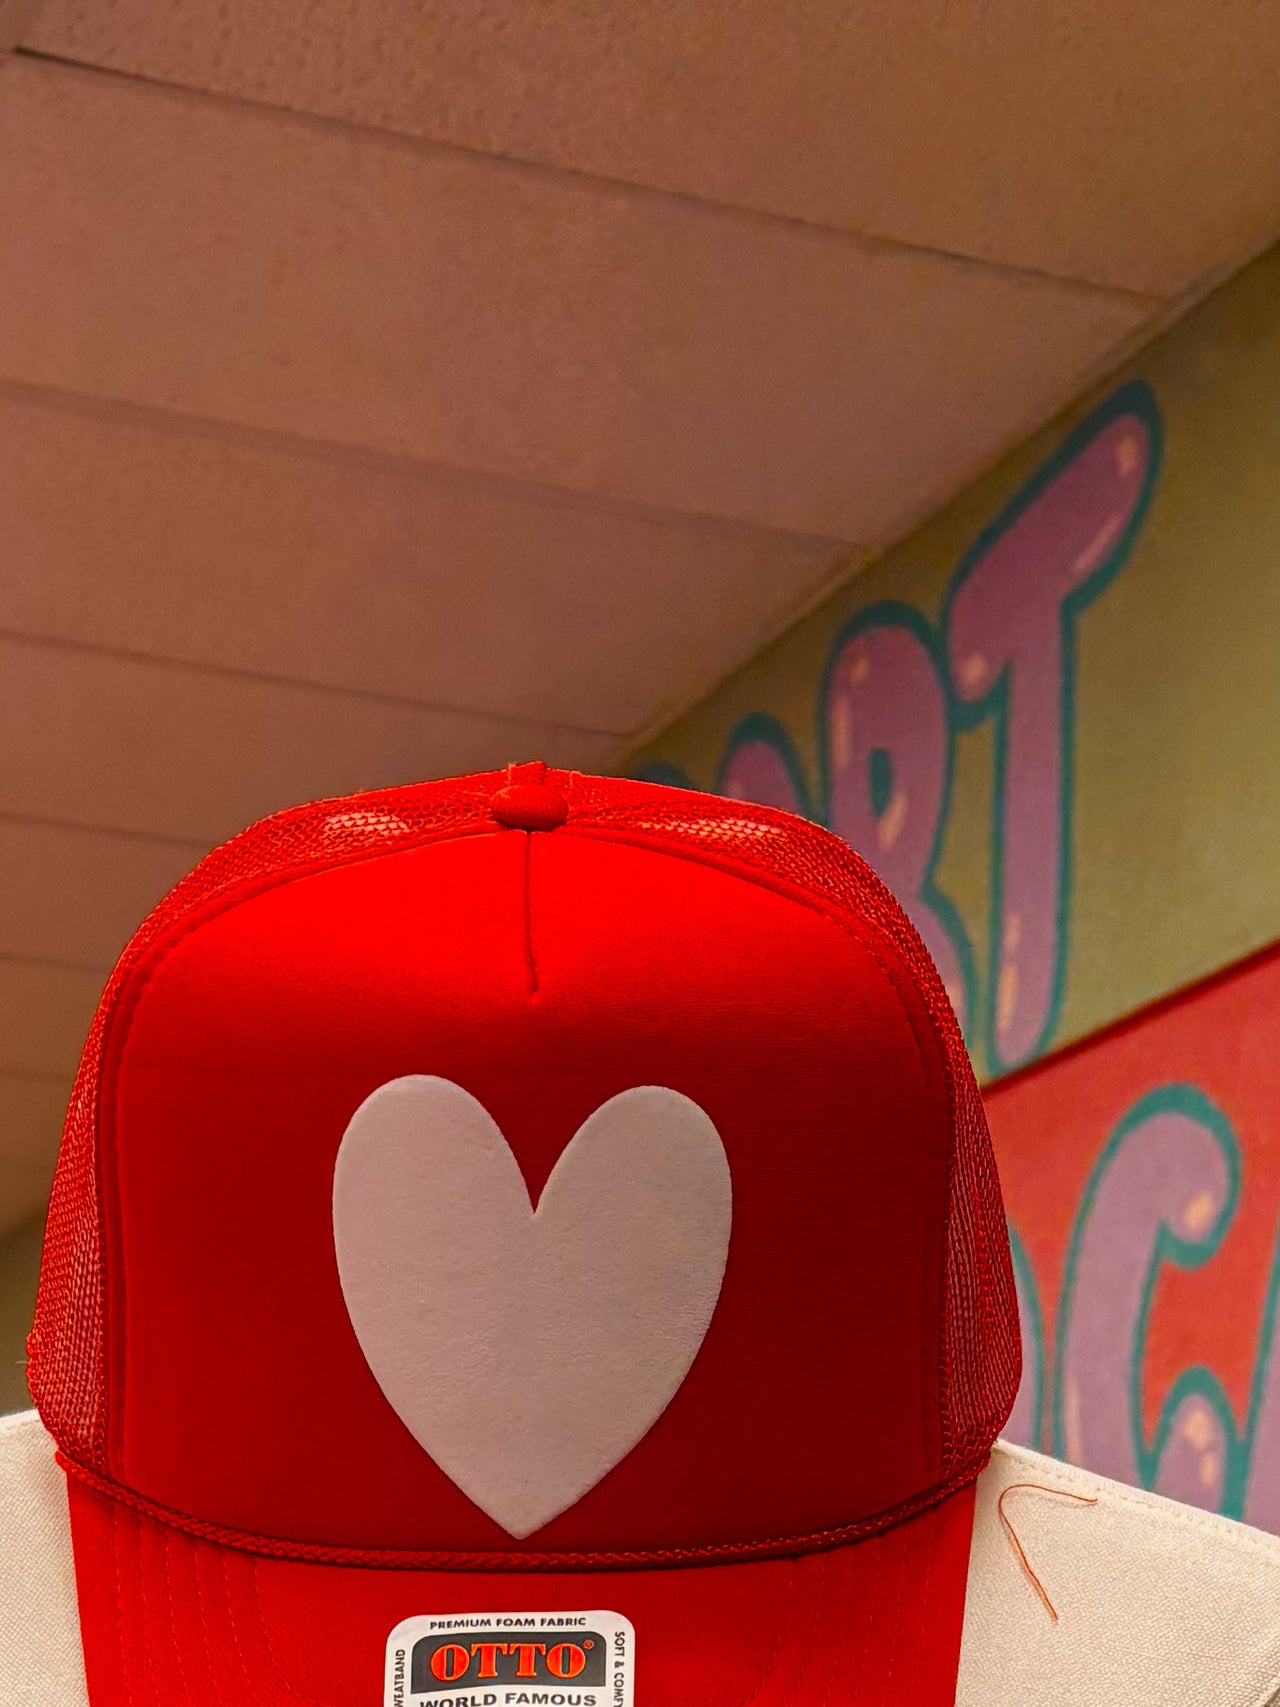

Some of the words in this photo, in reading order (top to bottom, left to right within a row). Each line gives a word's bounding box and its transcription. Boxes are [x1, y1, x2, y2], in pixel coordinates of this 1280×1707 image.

[430, 1618, 492, 1630] PREMIUM
[496, 1618, 535, 1628] FOAM
[540, 1617, 586, 1627] FABRIC
[614, 1631, 625, 1657] SOFT
[505, 1692, 597, 1707] FAMOUS
